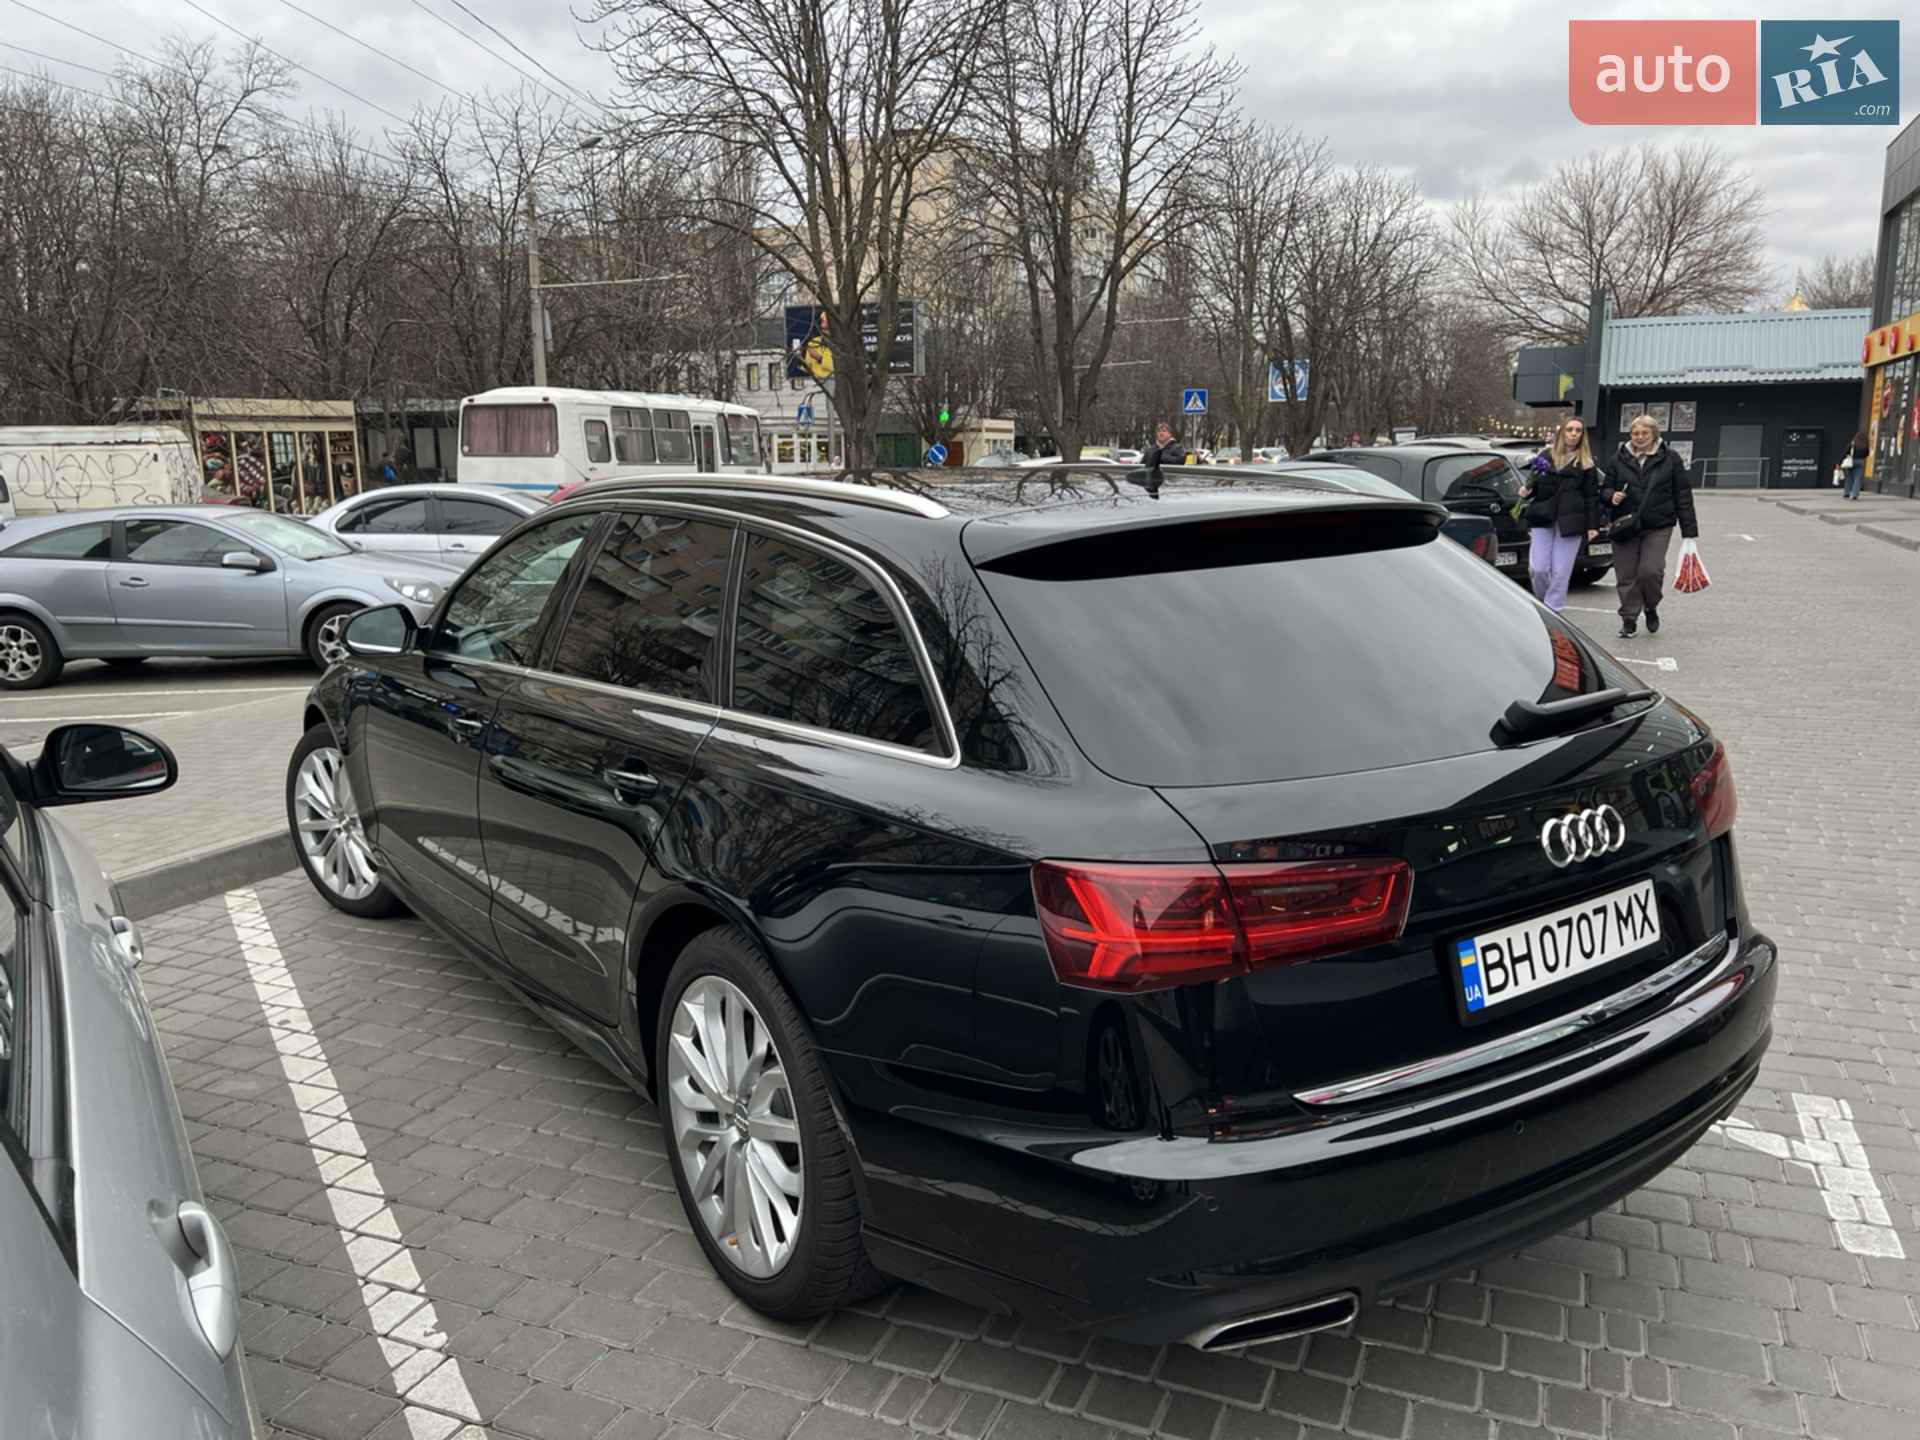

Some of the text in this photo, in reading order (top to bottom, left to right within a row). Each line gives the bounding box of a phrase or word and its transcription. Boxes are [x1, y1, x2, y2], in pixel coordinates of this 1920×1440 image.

[1480, 888, 1656, 996] BH 0707 MX
[1464, 984, 1482, 1002] UA
